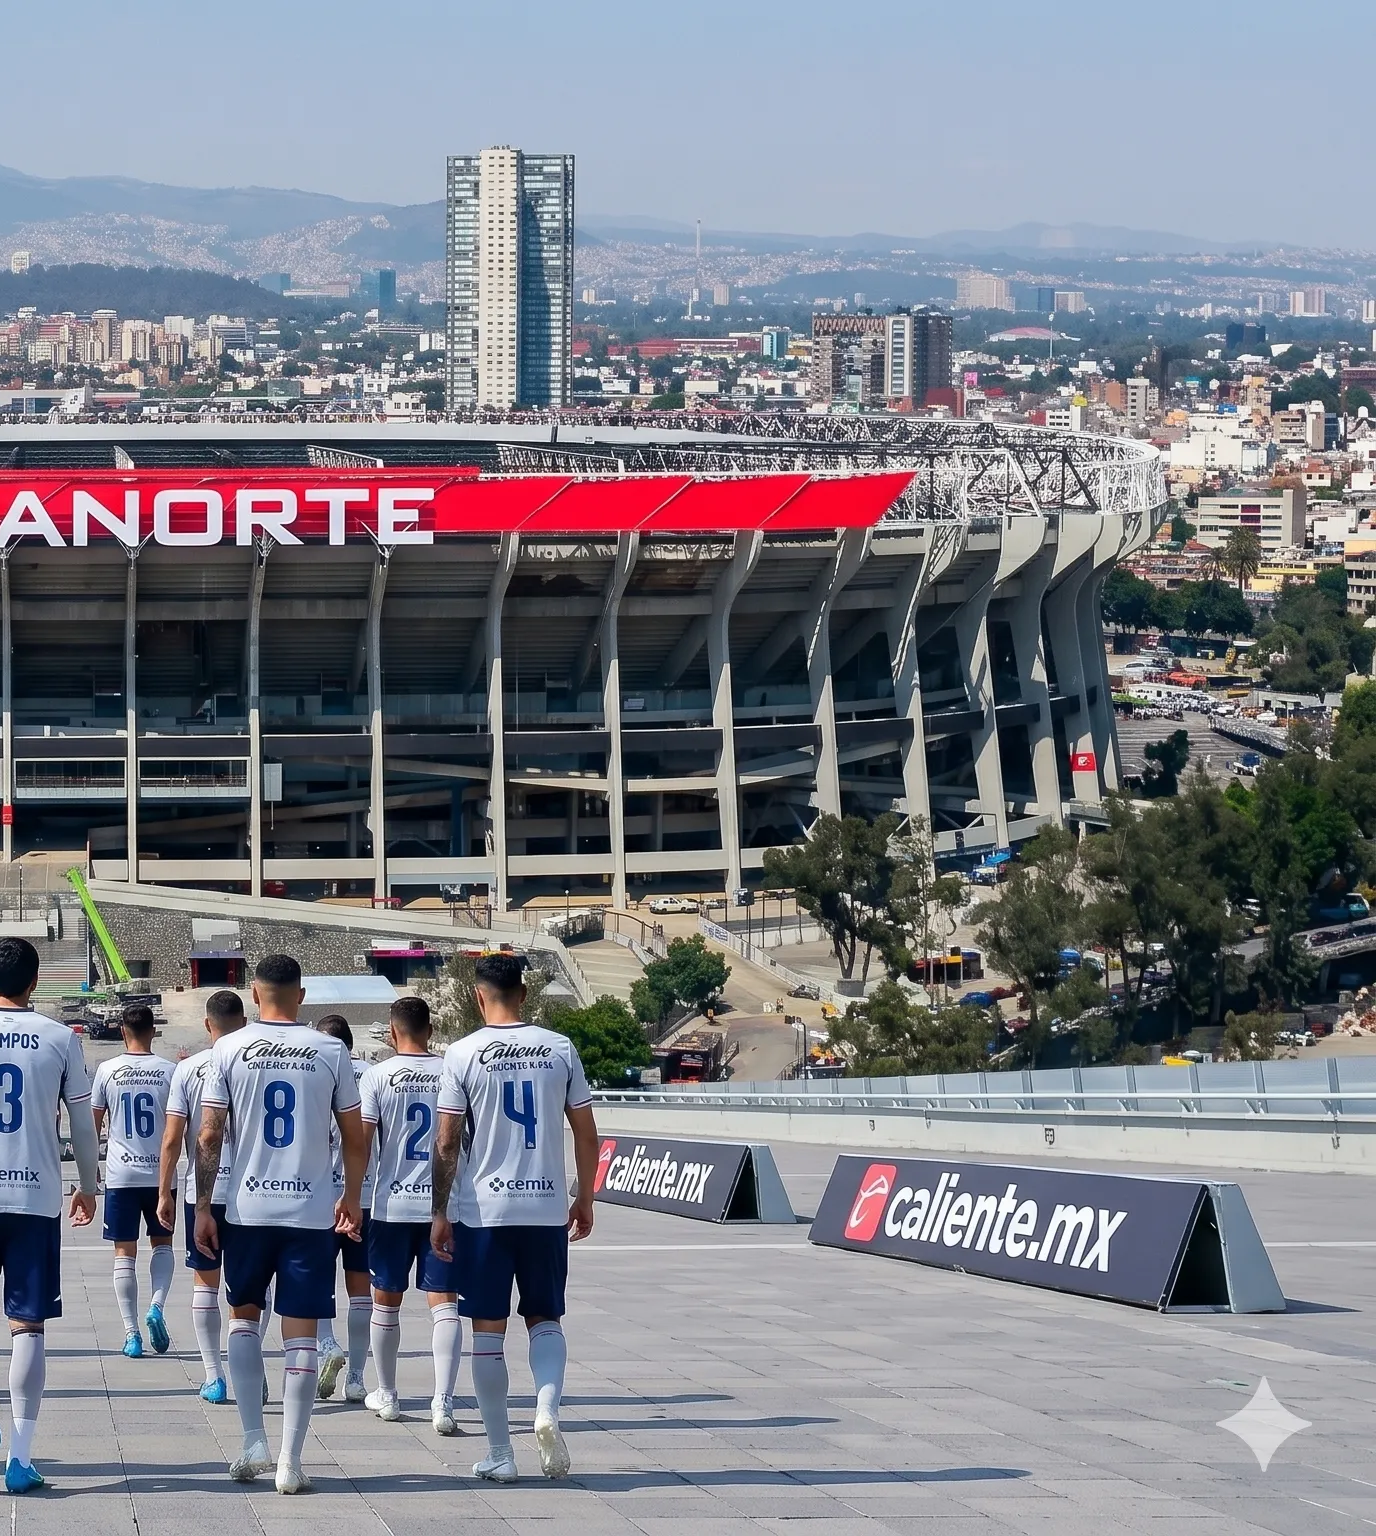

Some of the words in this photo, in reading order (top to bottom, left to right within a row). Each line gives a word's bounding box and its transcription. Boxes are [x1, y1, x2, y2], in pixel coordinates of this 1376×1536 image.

[120, 1092, 155, 1139] 16
[263, 1080, 296, 1149] 8
[405, 1102, 432, 1162] 2
[503, 1080, 538, 1150] 4
[262, 1177, 312, 1193] cemix
[404, 1182, 433, 1194] cem
[506, 1176, 554, 1191] cemix
[605, 1144, 715, 1204] caliente.mx
[884, 1172, 1128, 1273] caliente.mx
